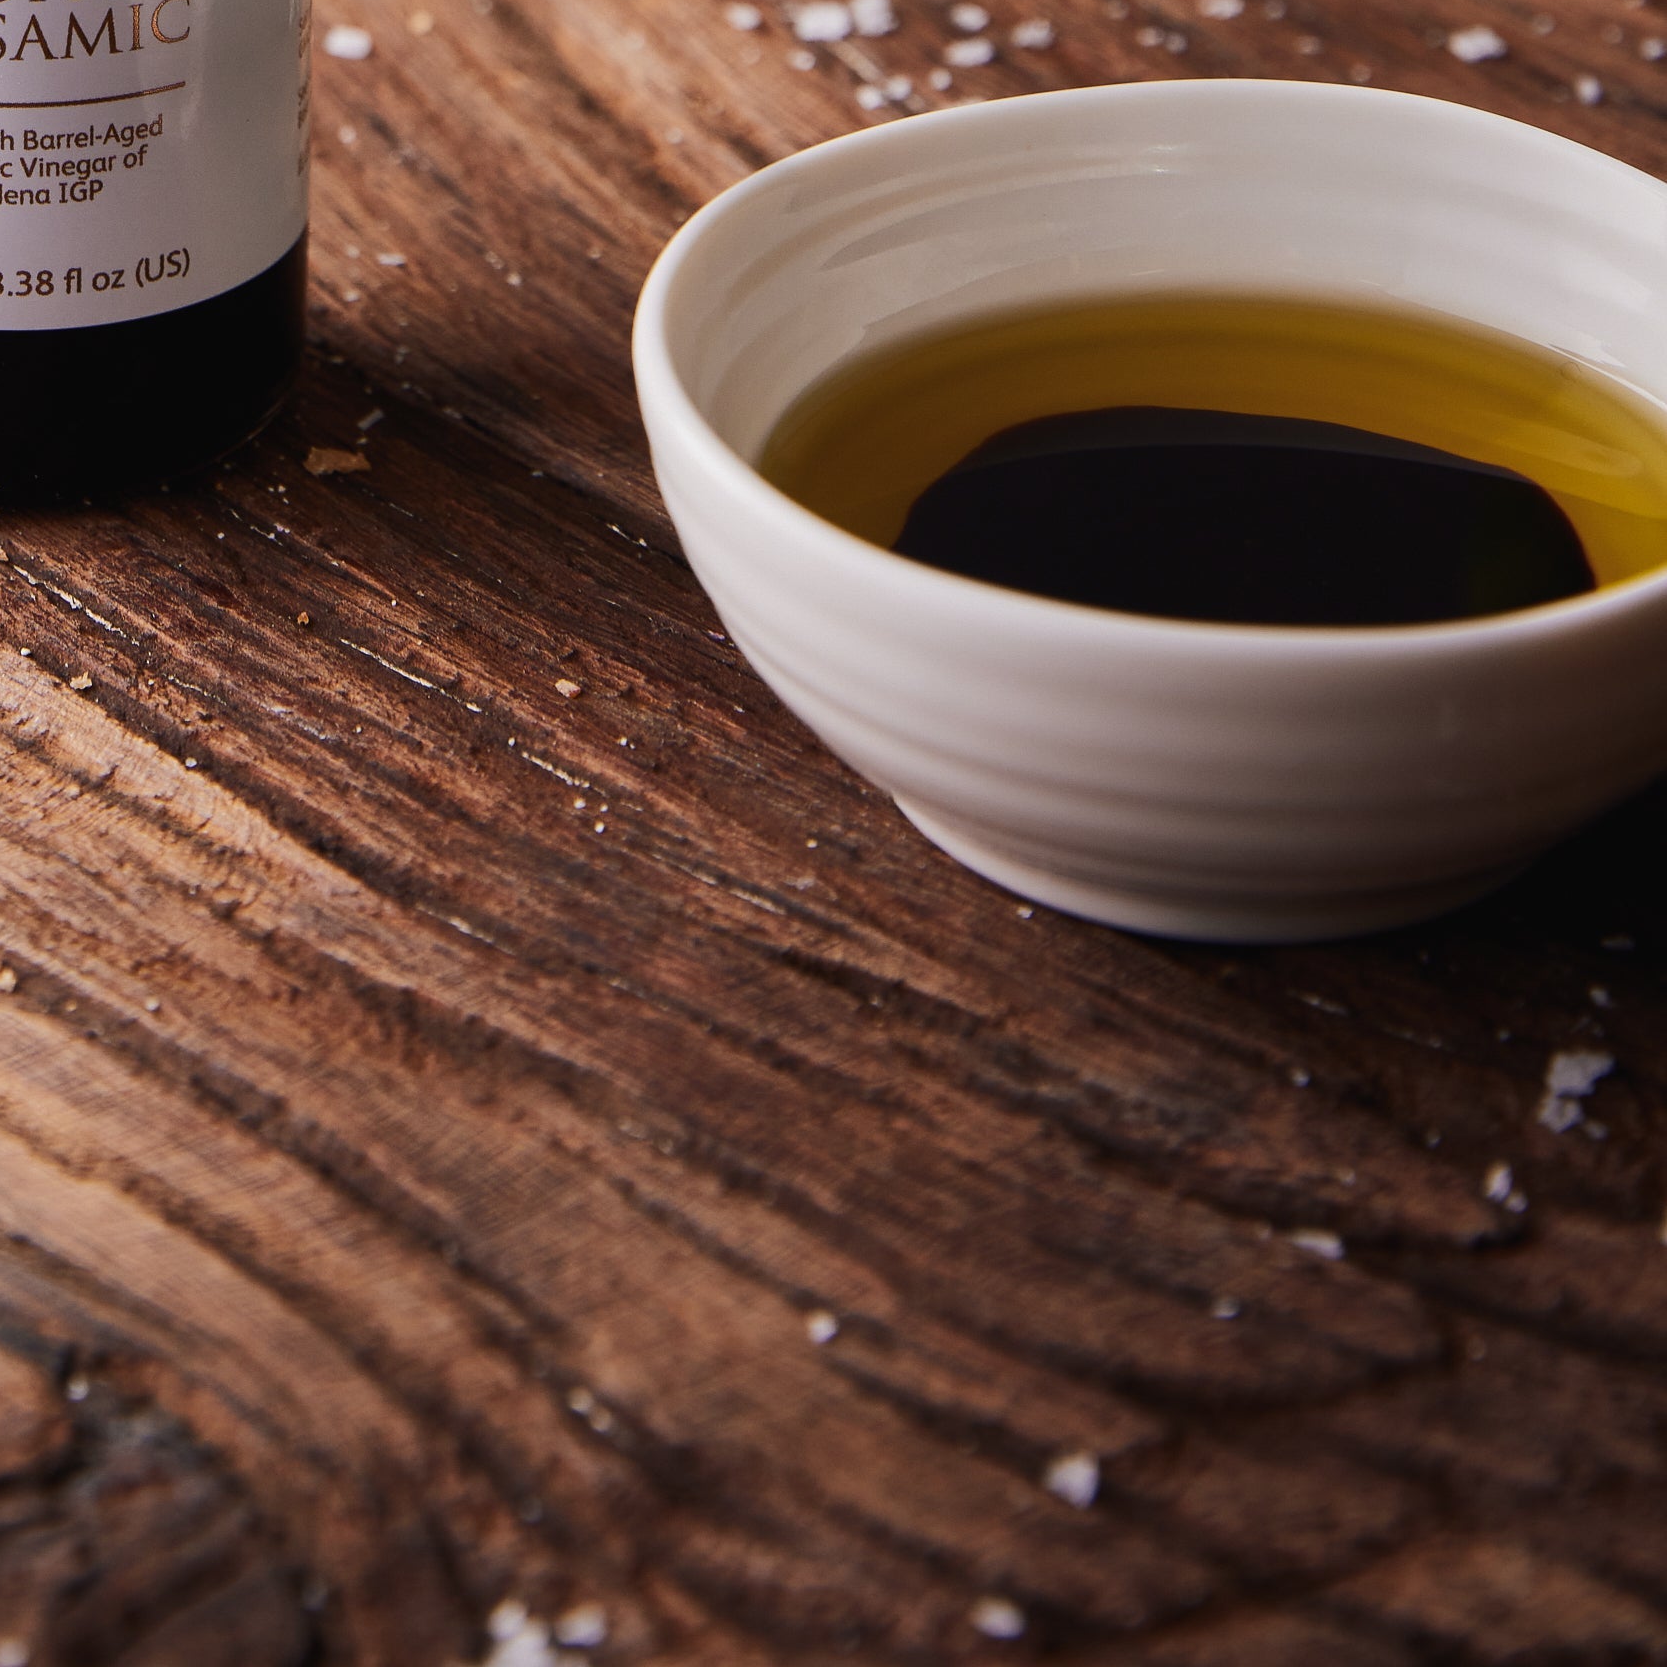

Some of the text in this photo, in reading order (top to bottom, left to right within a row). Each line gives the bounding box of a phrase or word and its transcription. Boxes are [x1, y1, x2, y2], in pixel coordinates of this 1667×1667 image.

[23, 113, 163, 150] Barrel-Aged
[19, 151, 117, 182] Vinegar
[122, 144, 149, 169] of
[59, 181, 104, 204] IGP
[63, 266, 83, 295] fl
[92, 269, 125, 292] oz
[135, 247, 191, 289] (US)
